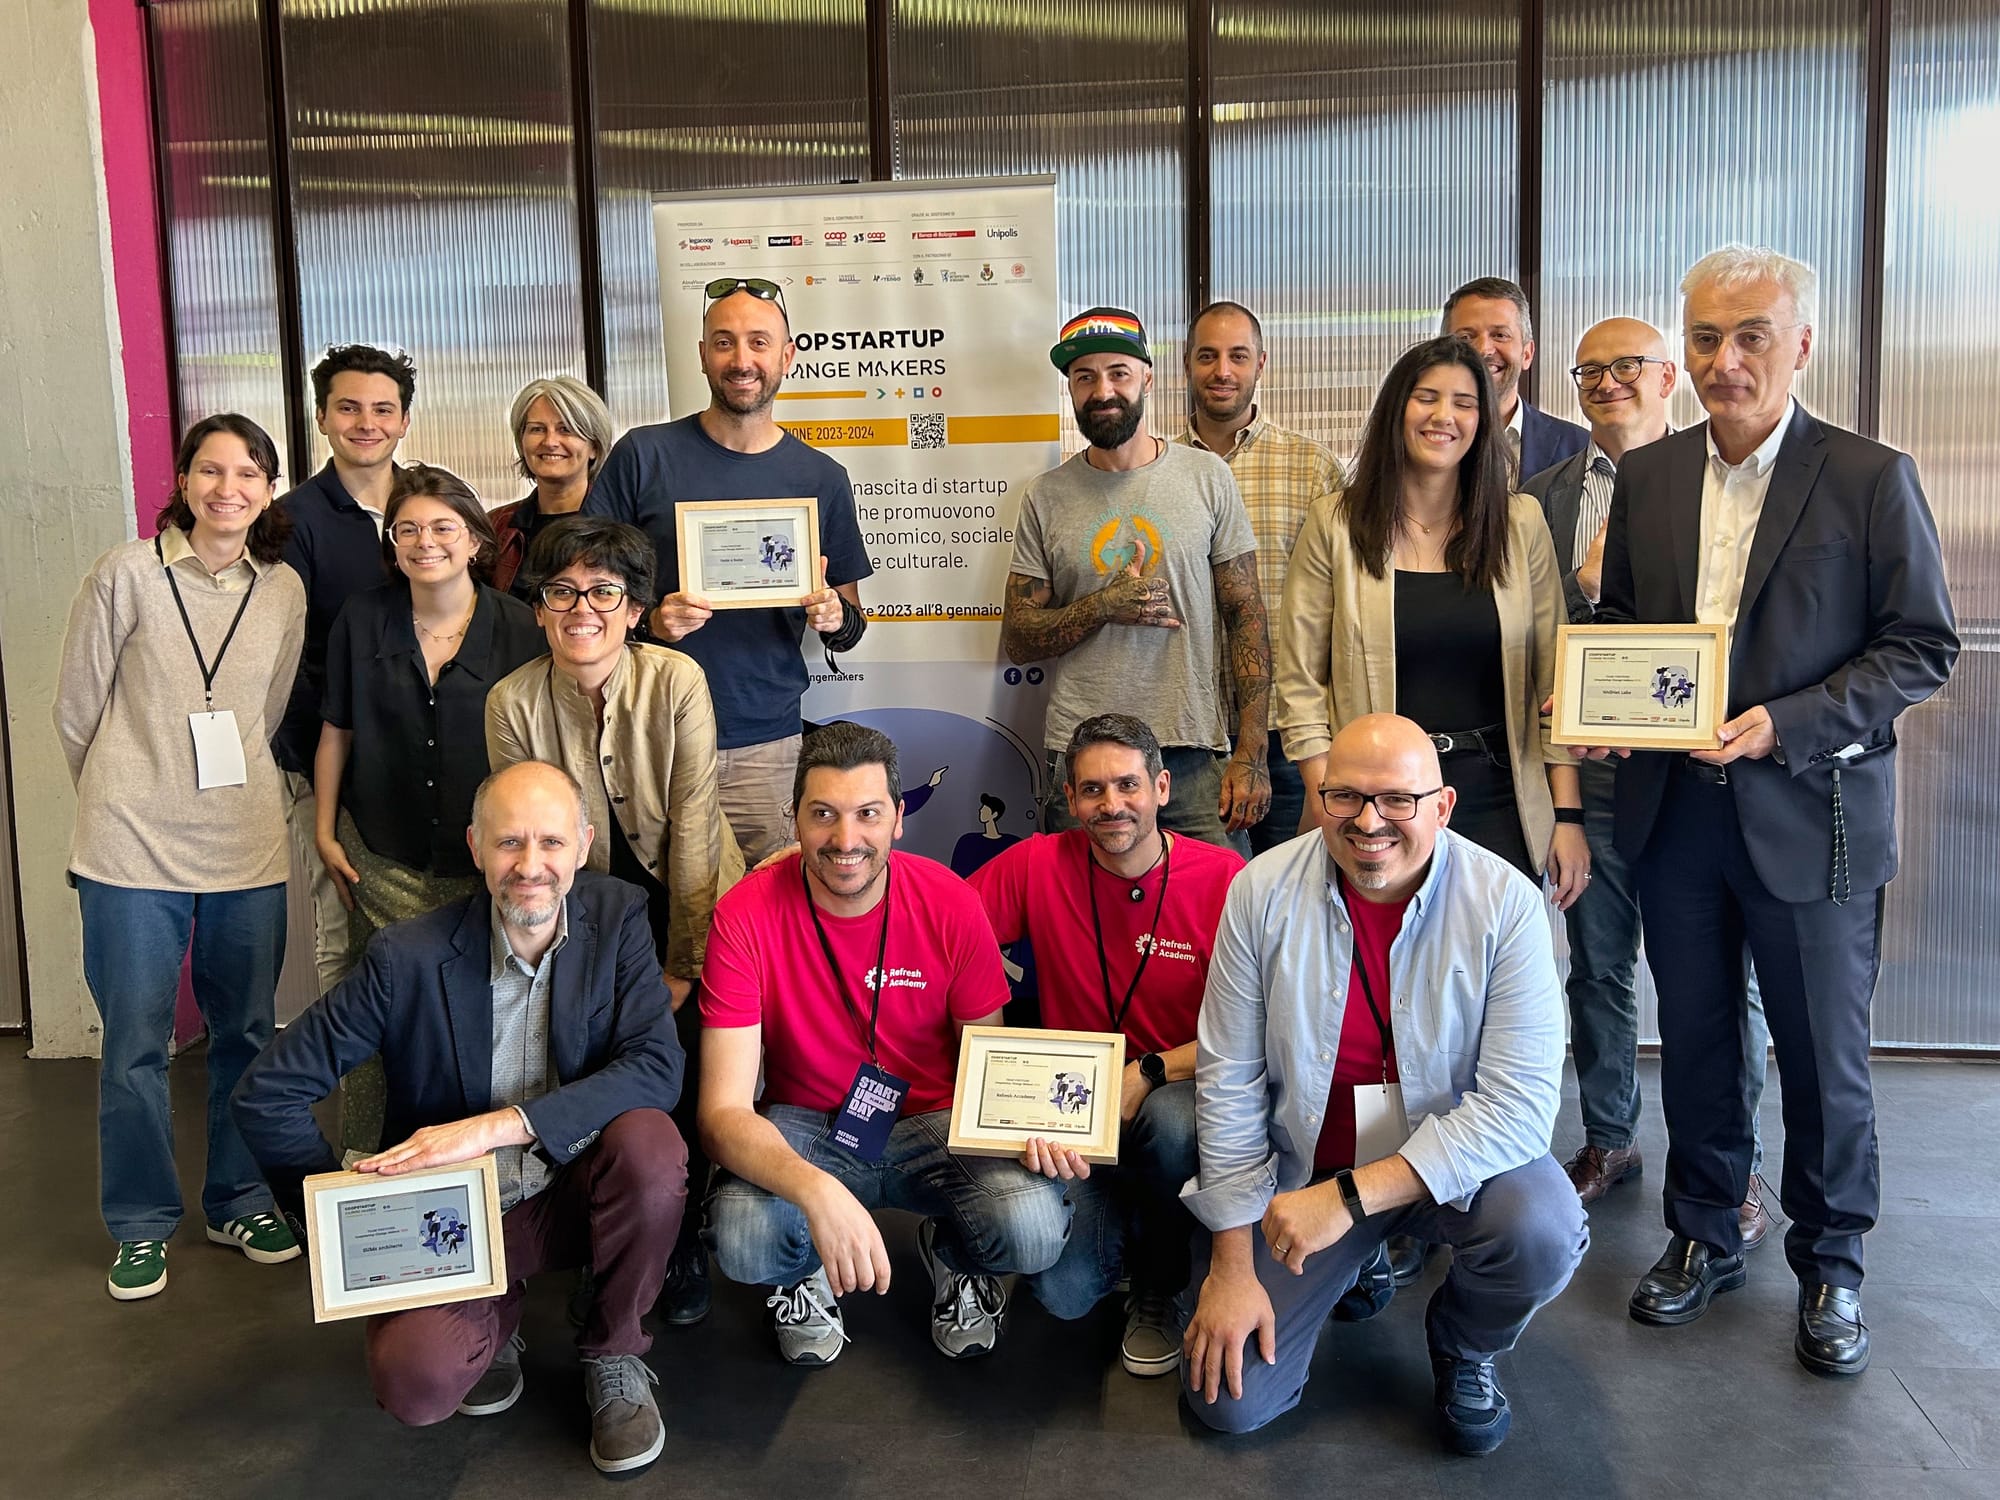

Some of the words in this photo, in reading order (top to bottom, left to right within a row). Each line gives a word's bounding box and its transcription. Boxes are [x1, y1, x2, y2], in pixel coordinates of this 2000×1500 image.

[986, 228, 1018, 240] Unipolis
[795, 329, 945, 352] OPSTARTUP
[785, 361, 850, 379] ANGE
[858, 359, 946, 377] MAKERS
[816, 425, 874, 440] 2023-2024
[853, 478, 917, 495] nascita
[922, 477, 937, 494] di
[942, 478, 1008, 497] startup
[858, 503, 879, 520] he
[884, 505, 995, 524] promuovono
[861, 527, 946, 545] onomico,
[951, 526, 1014, 543] sociale
[871, 556, 881, 569] e
[886, 551, 968, 569] culturale.
[877, 604, 912, 617] 2023
[915, 603, 943, 617] all'8
[946, 603, 1002, 619] gennaio
[809, 672, 865, 684] ngemakers
[1160, 938, 1192, 951] Refresh
[1158, 949, 1196, 963] Academy
[889, 967, 922, 978] Refresh
[889, 978, 927, 990] Academy
[859, 1076, 902, 1103] START
[848, 1097, 876, 1118] DAY
[834, 1135, 859, 1150] ACADEMY
